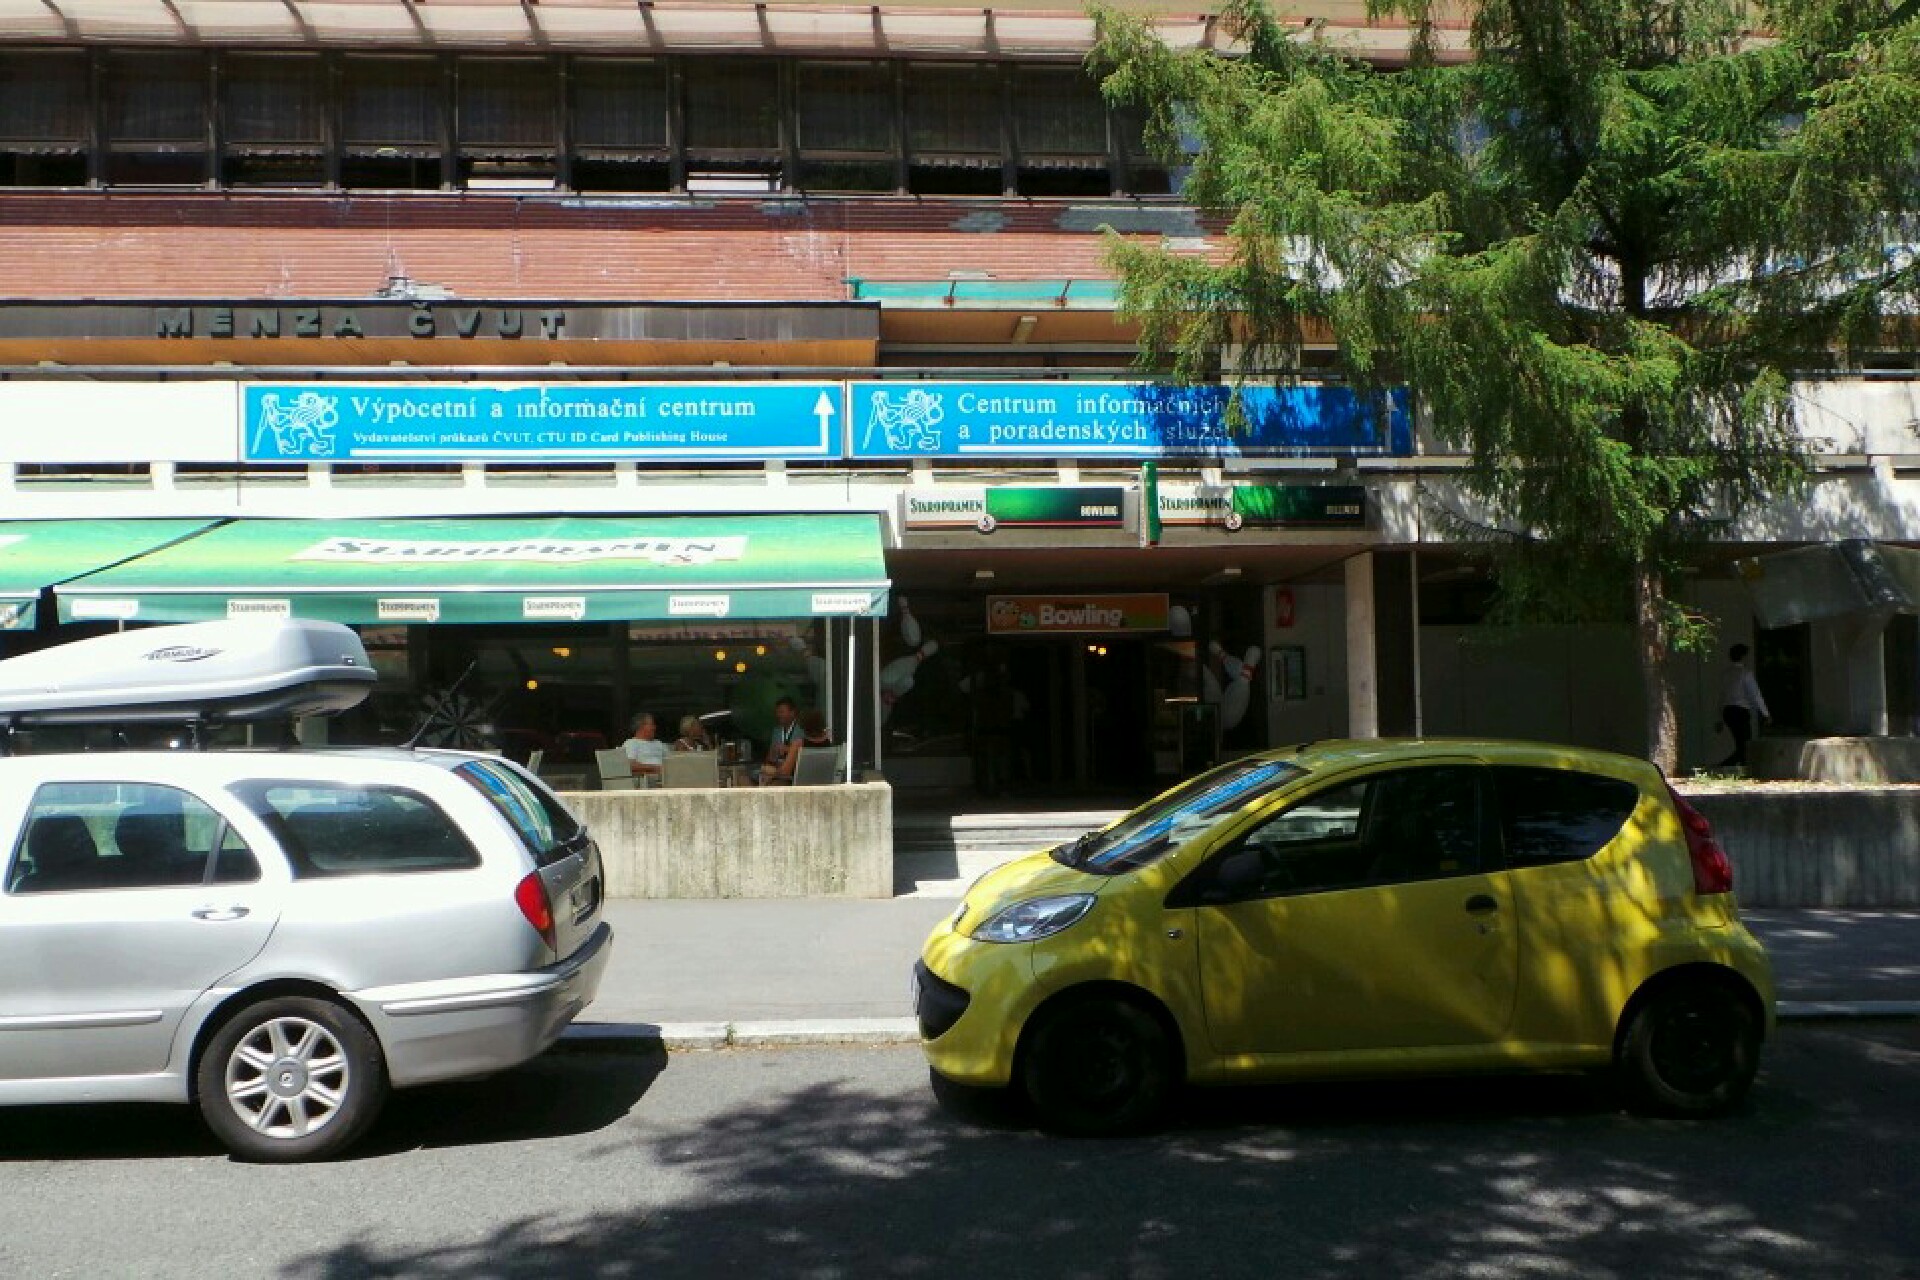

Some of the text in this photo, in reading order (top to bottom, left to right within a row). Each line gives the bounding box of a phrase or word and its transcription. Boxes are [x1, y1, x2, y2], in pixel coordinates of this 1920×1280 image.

[157, 302, 566, 340] MENZA ČVUT
[490, 403, 504, 418] a
[658, 399, 756, 416] centrum
[957, 393, 1058, 414] Centrum
[537, 432, 566, 442] CTU
[570, 432, 587, 442] ID
[591, 431, 619, 442] Card
[623, 431, 686, 443] Publishing
[690, 431, 728, 442] House
[958, 424, 971, 439] a
[990, 419, 1148, 443] poradenských
[1040, 604, 1122, 626] Bowling
